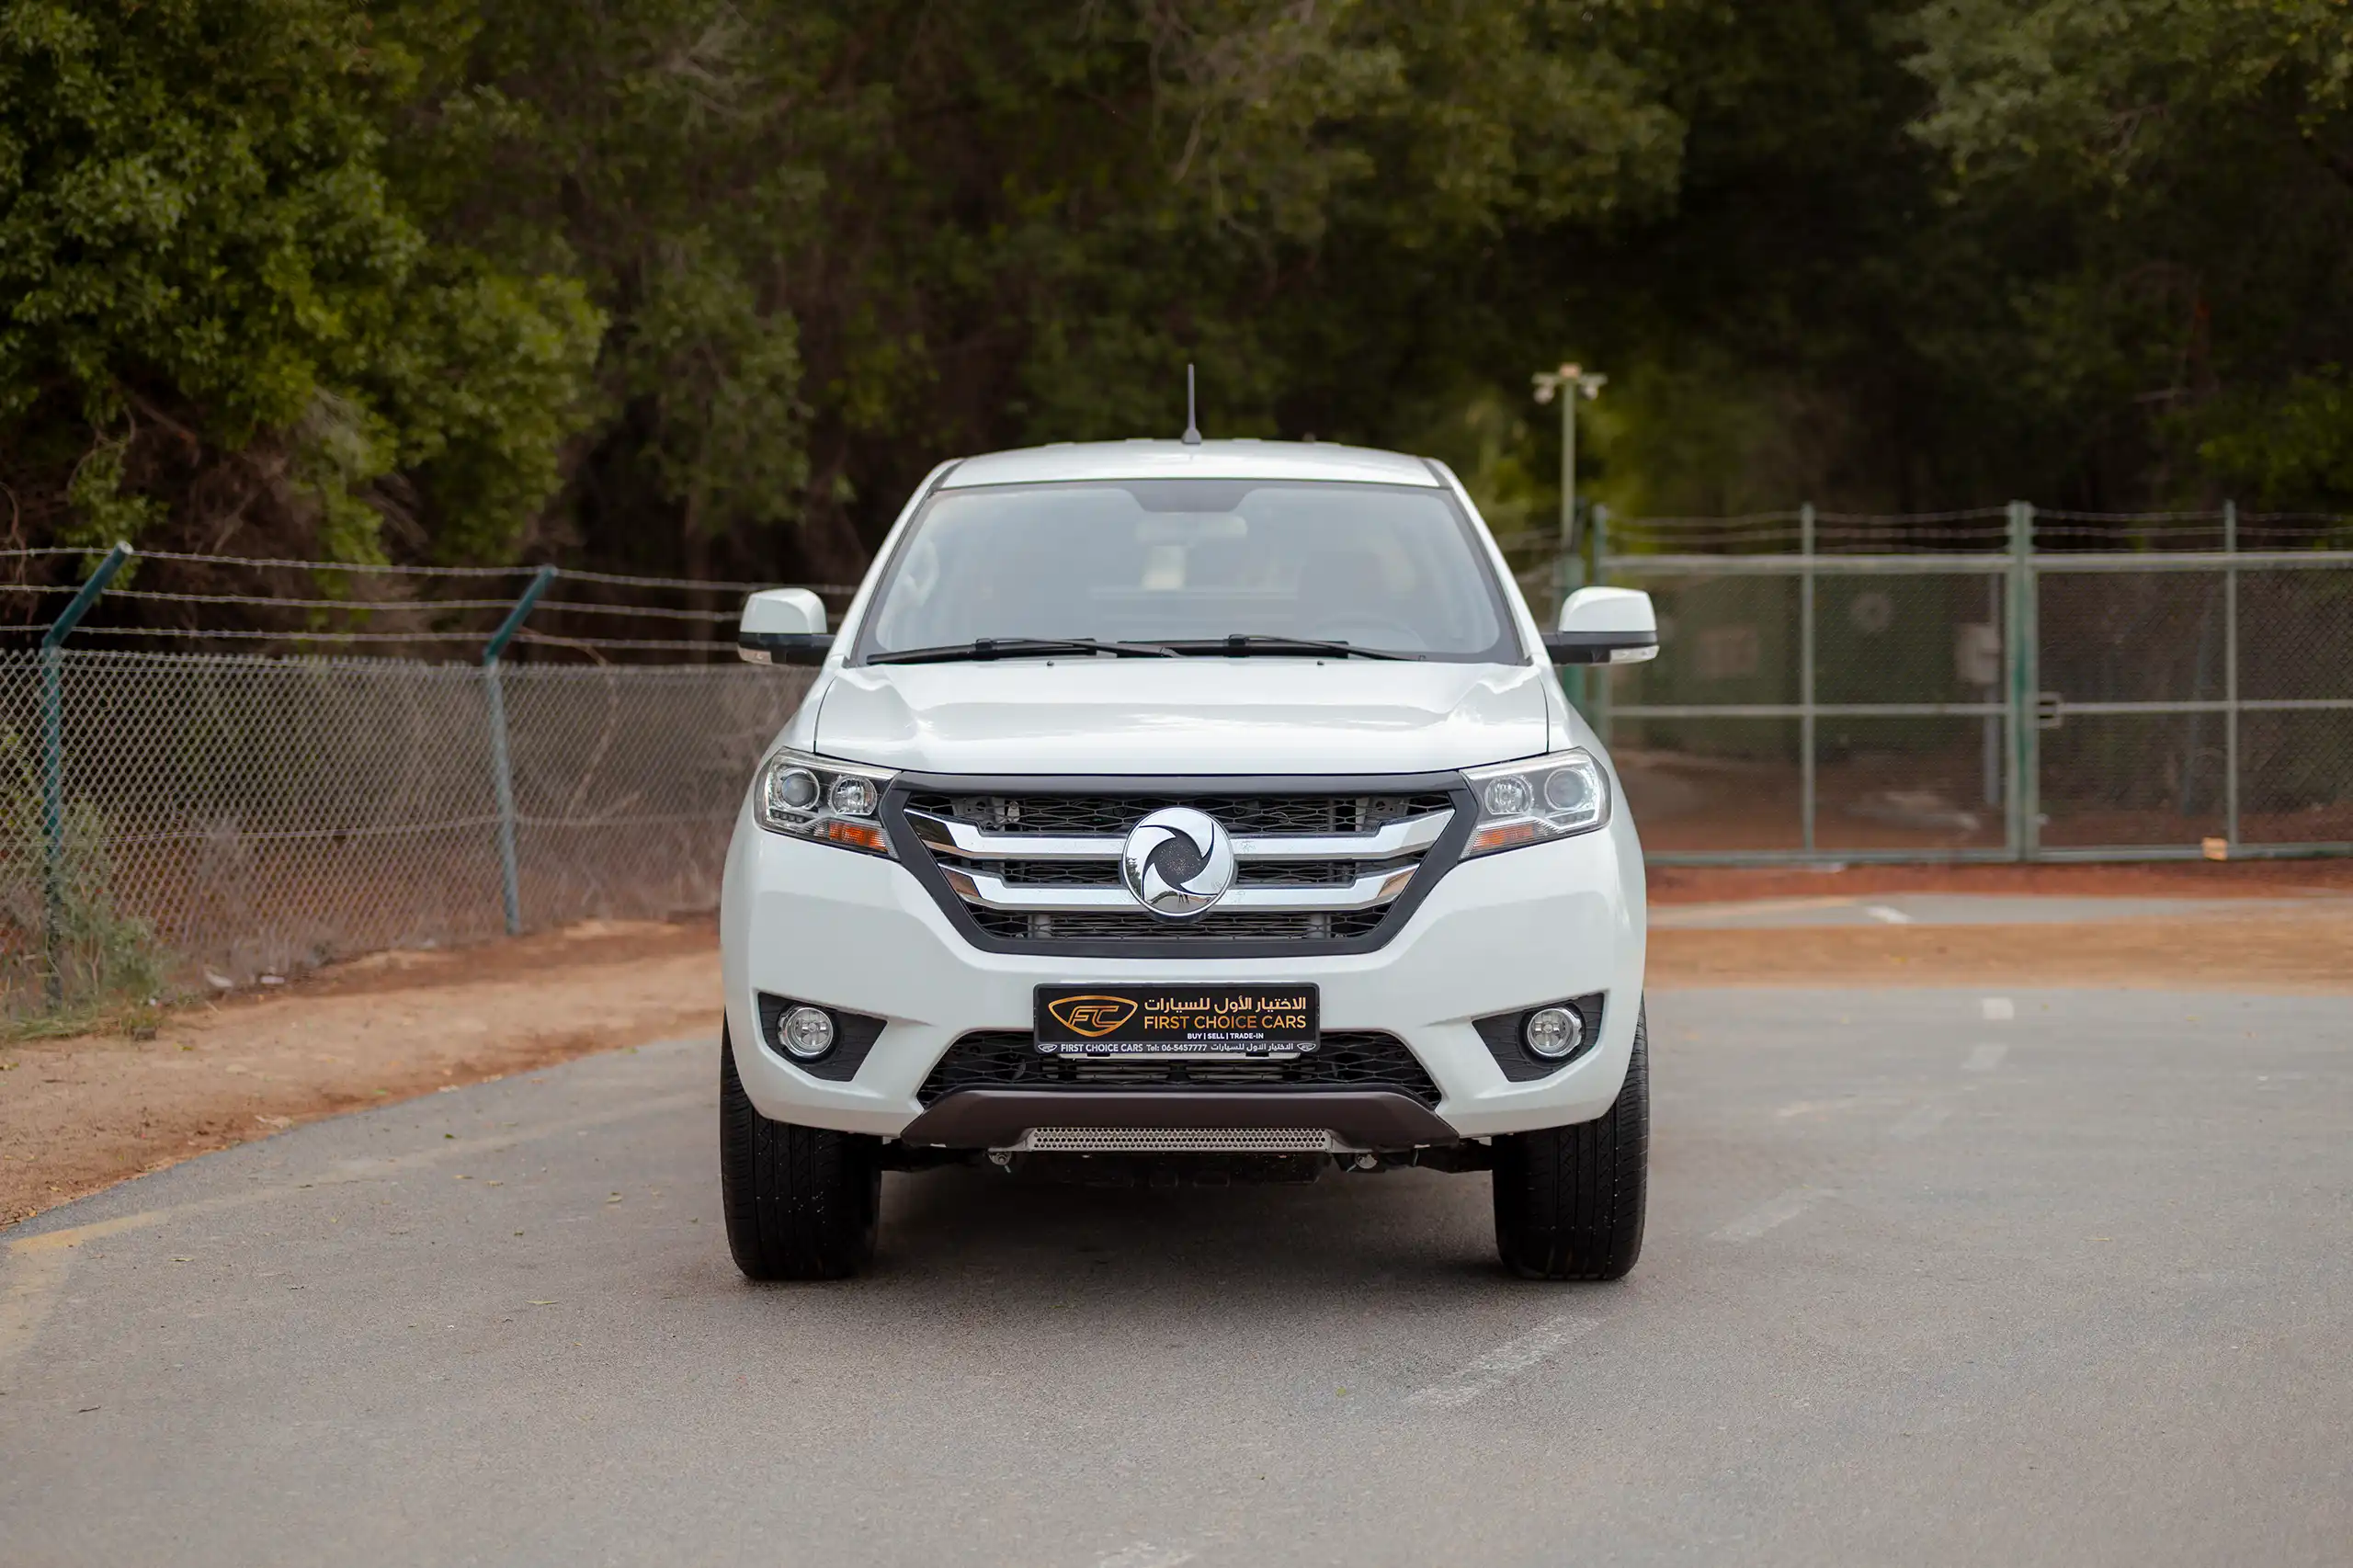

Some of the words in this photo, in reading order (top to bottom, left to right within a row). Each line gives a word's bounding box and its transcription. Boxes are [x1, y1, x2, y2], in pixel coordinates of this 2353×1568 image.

[1144, 997, 1211, 1014] للسيارات
[1214, 994, 1252, 1015] الأول
[1255, 996, 1307, 1013] الاختيار
[1144, 1016, 1190, 1029] FIRST
[1194, 1015, 1257, 1029] CHOICE
[1261, 1015, 1307, 1029] CARS
[1061, 1043, 1085, 1052] FIRST
[1086, 1043, 1118, 1052] CHOICE
[1120, 1043, 1143, 1052] CARS
[1145, 1043, 1160, 1052] Tel:
[1161, 1043, 1208, 1052] 06-5457777
[1211, 1042, 1245, 1052] للسيارات
